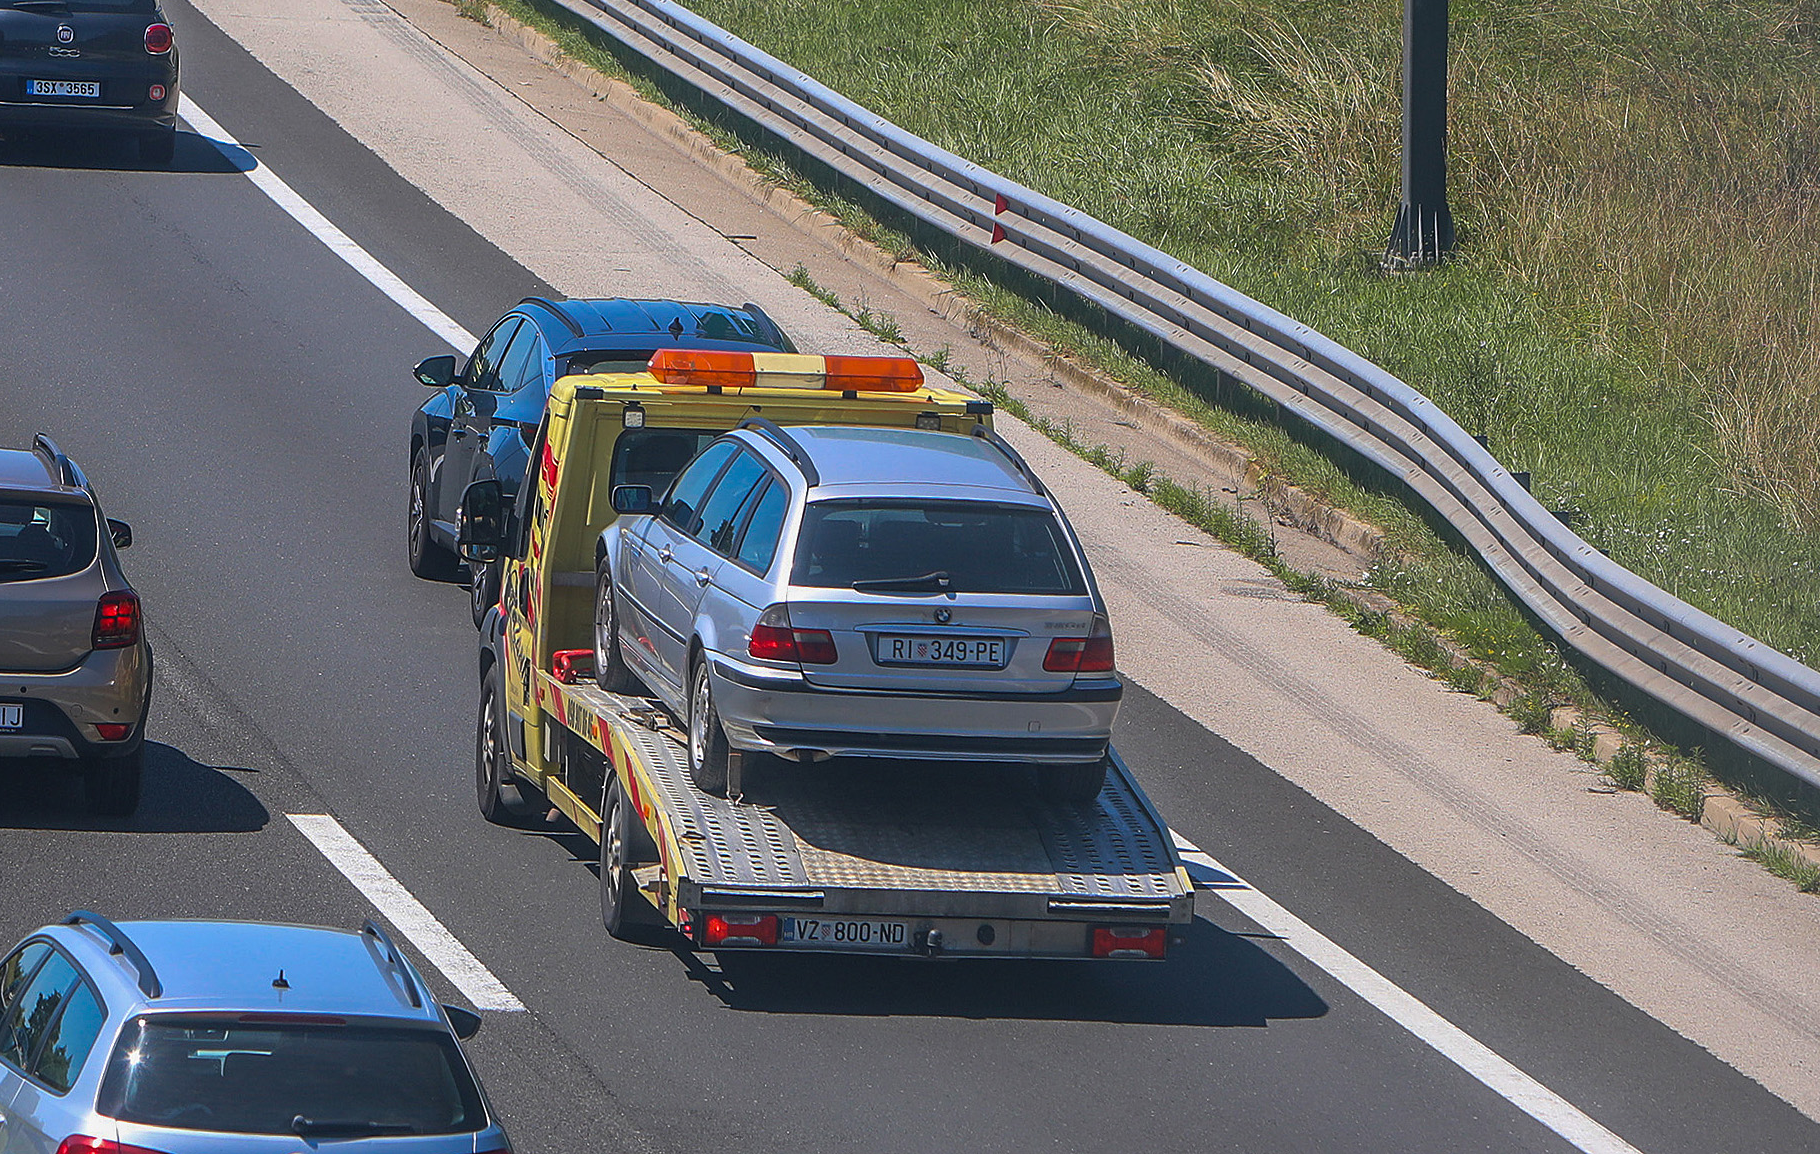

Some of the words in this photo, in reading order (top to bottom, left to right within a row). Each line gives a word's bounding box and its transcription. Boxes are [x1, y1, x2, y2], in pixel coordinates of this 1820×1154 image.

[36, 81, 57, 94] 3SX
[66, 82, 95, 95] 3565
[892, 639, 912, 659] RI
[930, 640, 1000, 662] 349-PE
[796, 920, 819, 940] VZ
[834, 921, 905, 943] 800-ND
